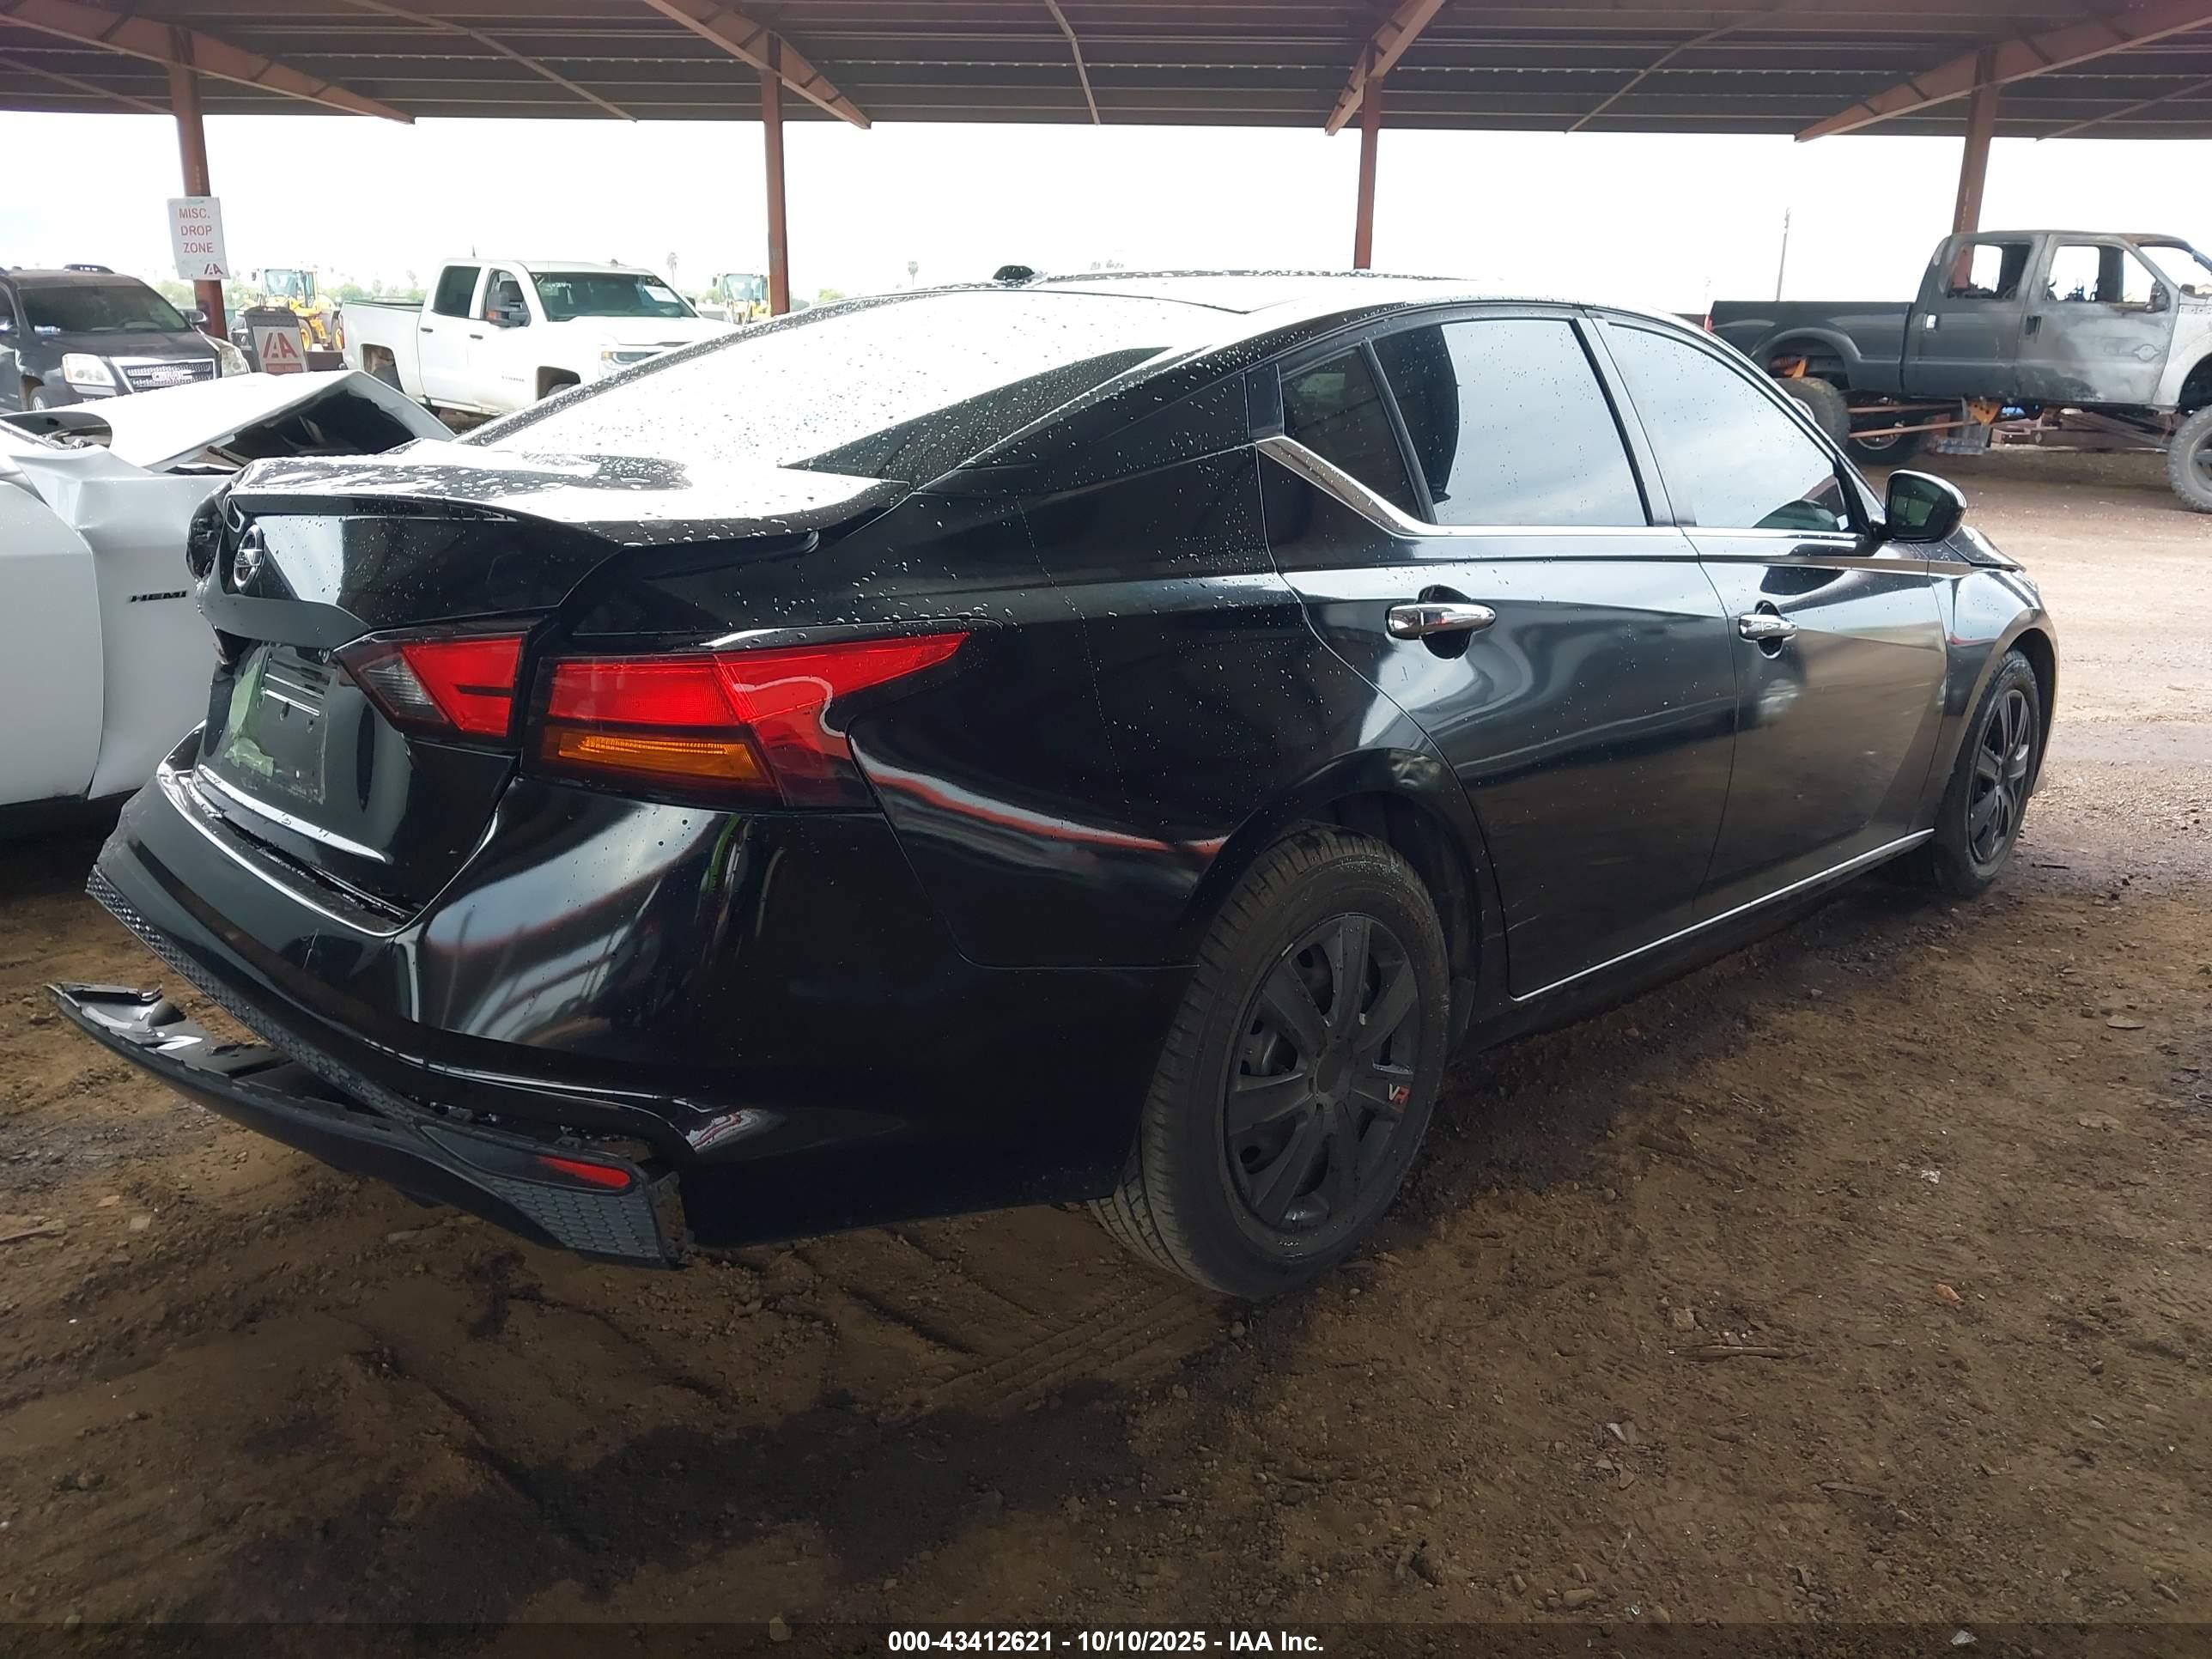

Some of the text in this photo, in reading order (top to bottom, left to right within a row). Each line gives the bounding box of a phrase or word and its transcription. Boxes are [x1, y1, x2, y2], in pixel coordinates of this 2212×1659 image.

[179, 208, 210, 219] MISC.
[180, 225, 212, 236] DROP
[183, 242, 214, 253] ZONE
[151, 370, 193, 382] GMC
[131, 590, 187, 602] HEMI
